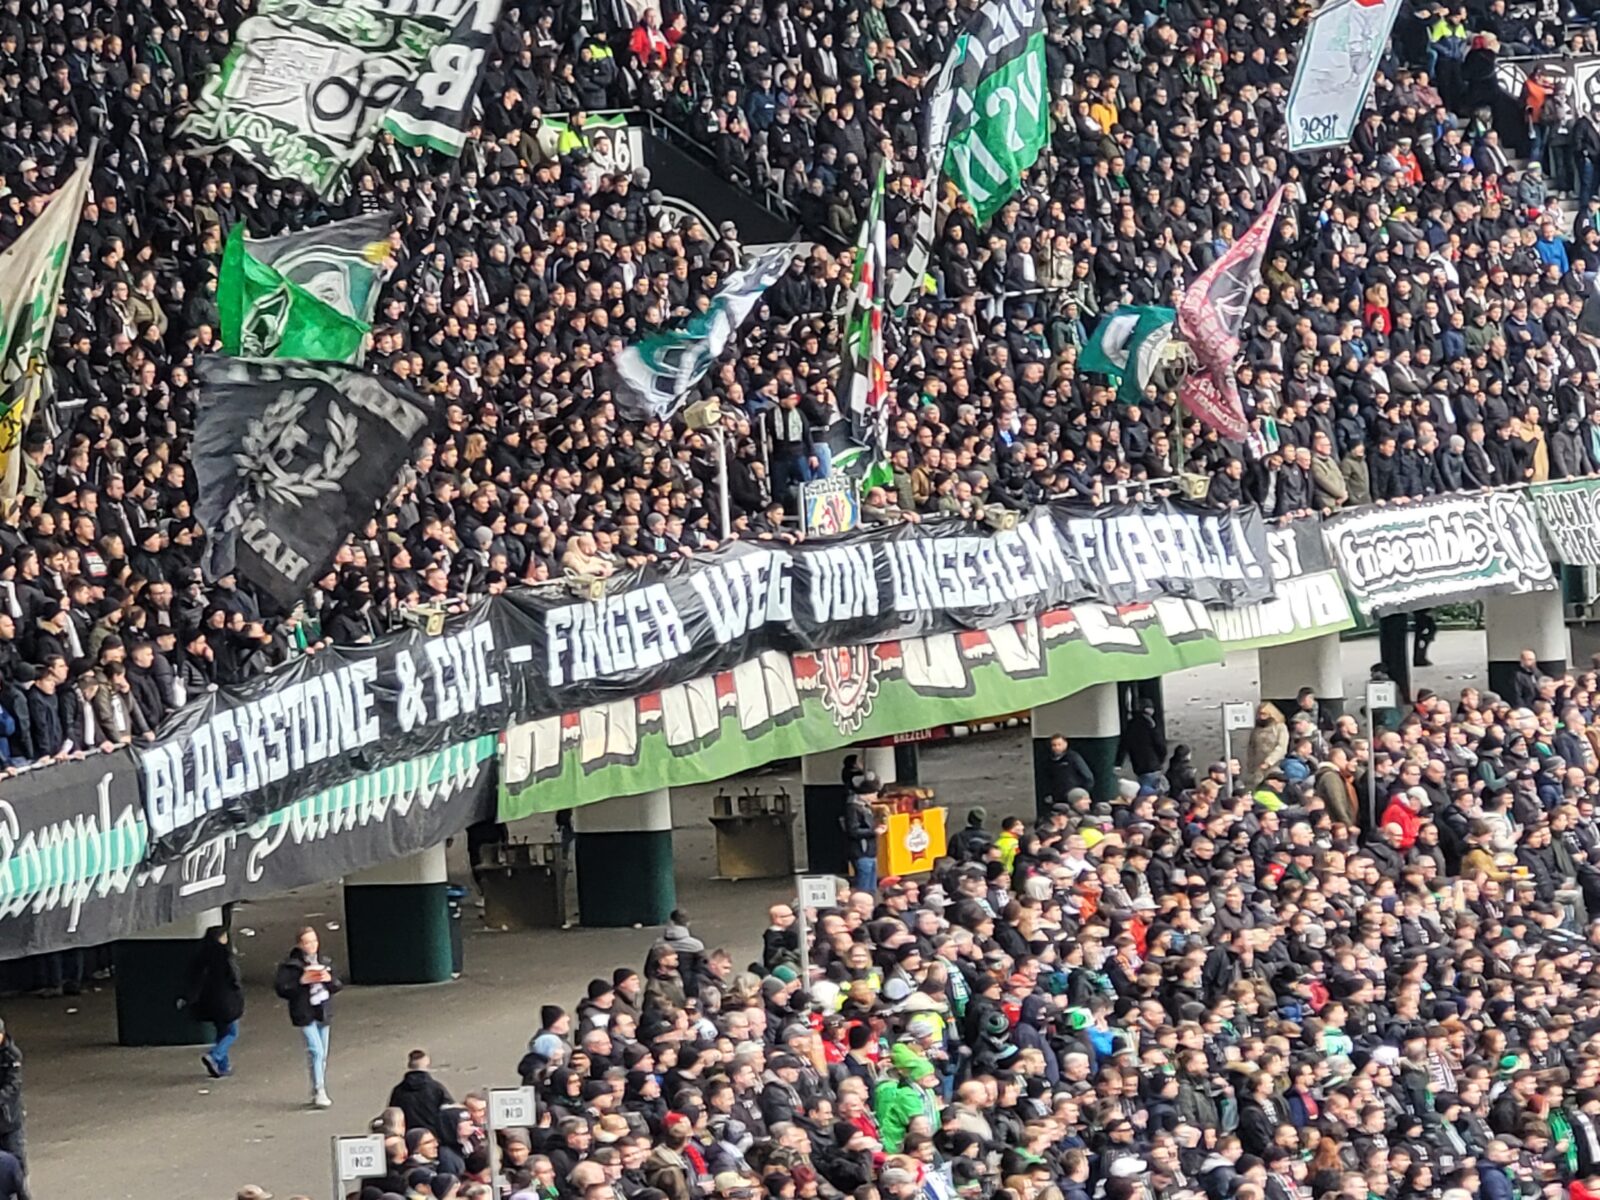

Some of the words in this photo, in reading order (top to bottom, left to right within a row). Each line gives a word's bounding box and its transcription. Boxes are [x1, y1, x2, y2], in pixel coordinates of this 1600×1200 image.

[1340, 513, 1489, 589] Ensemble
[142, 657, 380, 838] BLACKSTONE
[396, 650, 428, 733] &
[424, 621, 502, 722] CVC
[545, 583, 692, 687] FINGER
[690, 550, 793, 644] WEG
[802, 542, 879, 623] VON
[884, 515, 1075, 612] UNSEREM
